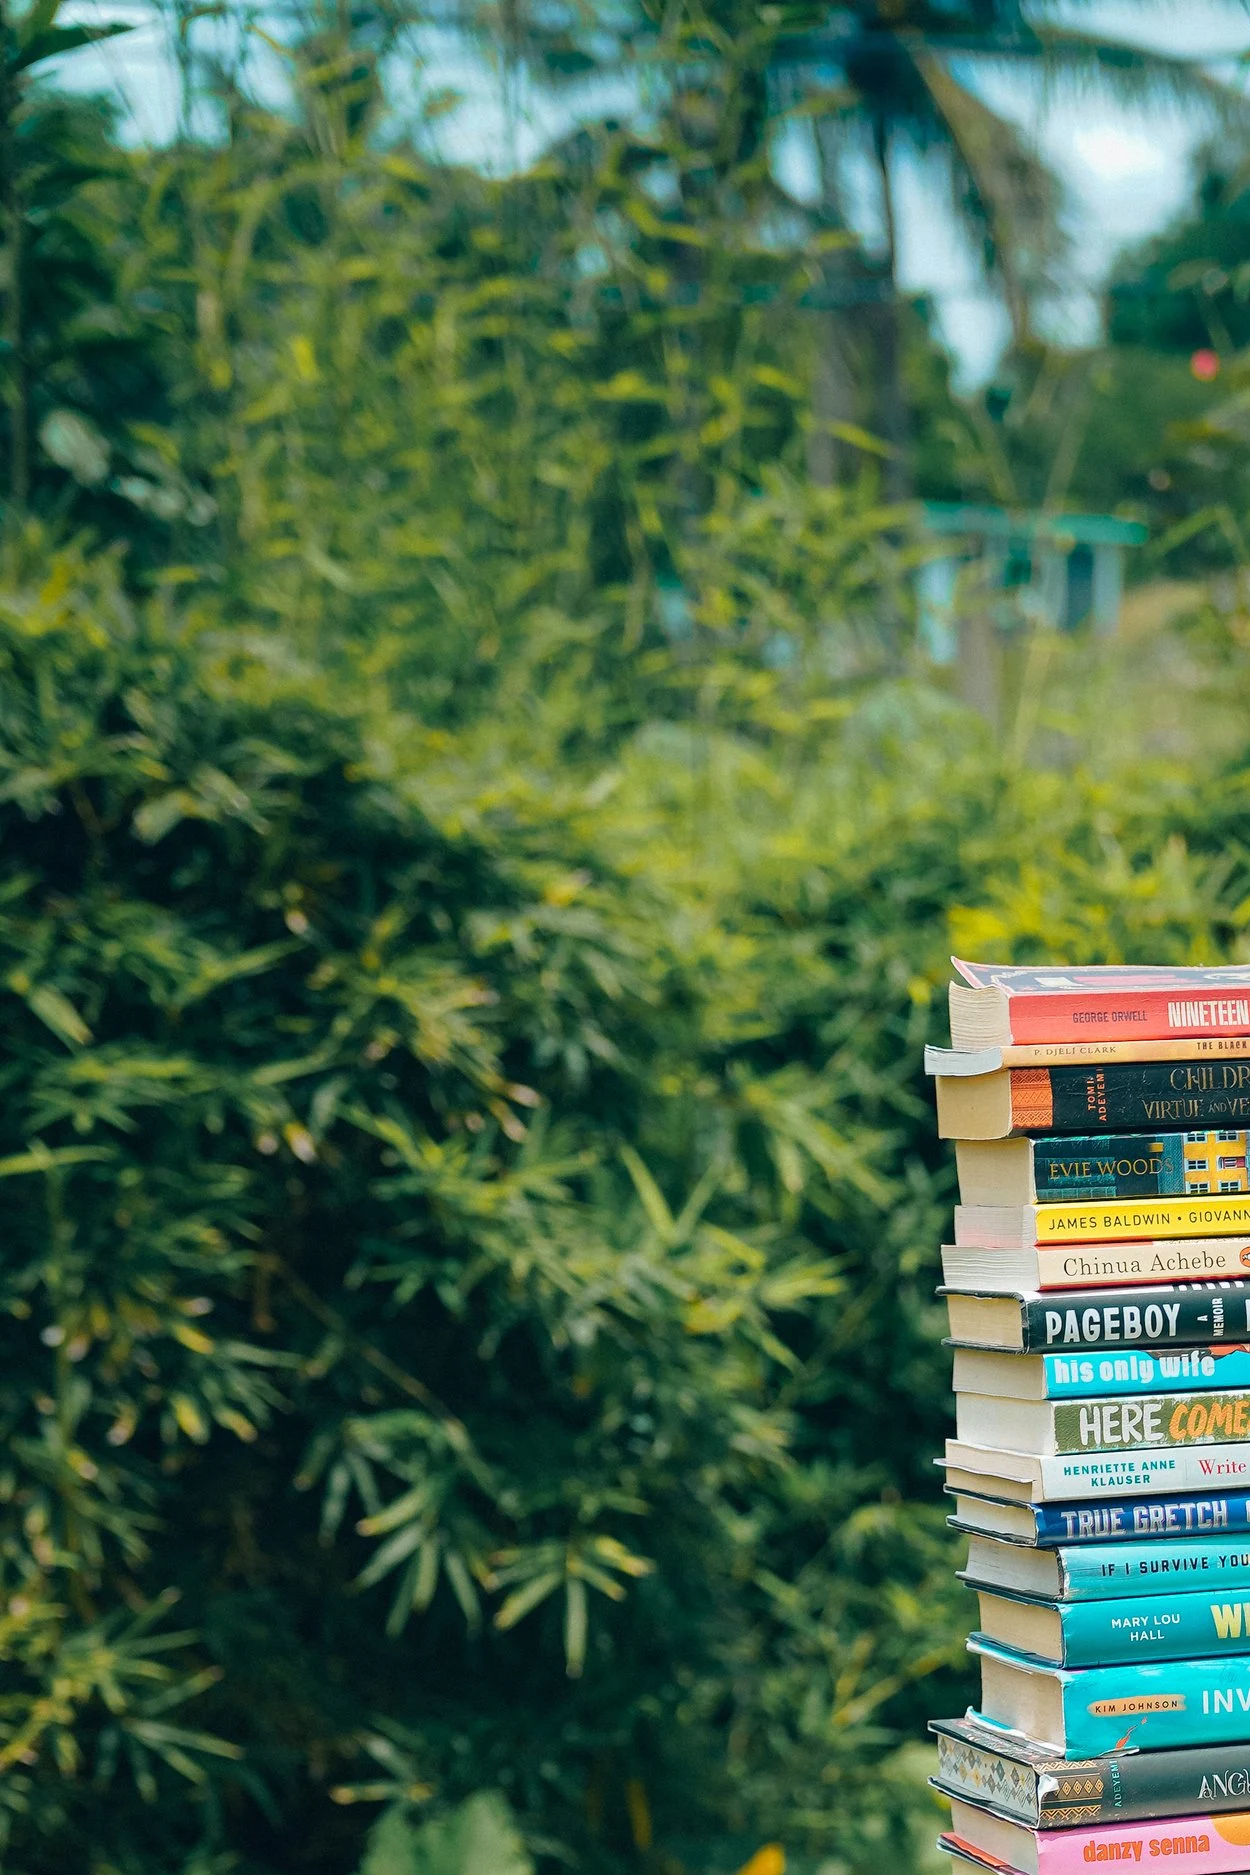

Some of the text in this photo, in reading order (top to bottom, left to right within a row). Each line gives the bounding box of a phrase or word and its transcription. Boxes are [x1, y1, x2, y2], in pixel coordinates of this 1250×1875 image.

[1073, 1010, 1147, 1023] GEORGE ORWELL
[1168, 1000, 1249, 1027] NINETEEN
[1080, 1046, 1116, 1054] CLARK
[1197, 1042, 1213, 1050] THE
[1218, 1041, 1247, 1049] BLACK
[1087, 1080, 1096, 1110] TOMI
[1096, 1068, 1107, 1121] ADEYEMI
[1141, 1099, 1204, 1120] VIRTUE
[1208, 1102, 1226, 1113] AND
[1049, 1157, 1174, 1179] EVIE WOODS
[1049, 1216, 1097, 1230] JAMES
[1104, 1213, 1170, 1227] BALDWIN
[1063, 1251, 1226, 1277] Chinua Achebe
[1045, 1303, 1181, 1344] PAGEBOY
[1197, 1314, 1208, 1322] A
[1212, 1297, 1223, 1337] MEMOIR
[1054, 1350, 1216, 1384] his only wife
[1079, 1403, 1164, 1446] HERE
[1064, 1459, 1176, 1476] HENRIETTE ANNE
[1198, 1458, 1246, 1476] Write
[1091, 1474, 1151, 1487] KLAUSER
[1060, 1500, 1228, 1539] TRUE GRETCH
[1102, 1553, 1249, 1577] IF I SURVIVE YOU
[1111, 1613, 1181, 1629] MARY LOU
[1130, 1630, 1165, 1641] HALL
[1095, 1700, 1178, 1713] KIM JOHNSON
[1109, 1760, 1122, 1807] ADEYEMI
[1083, 1834, 1210, 1863] danzy senna
